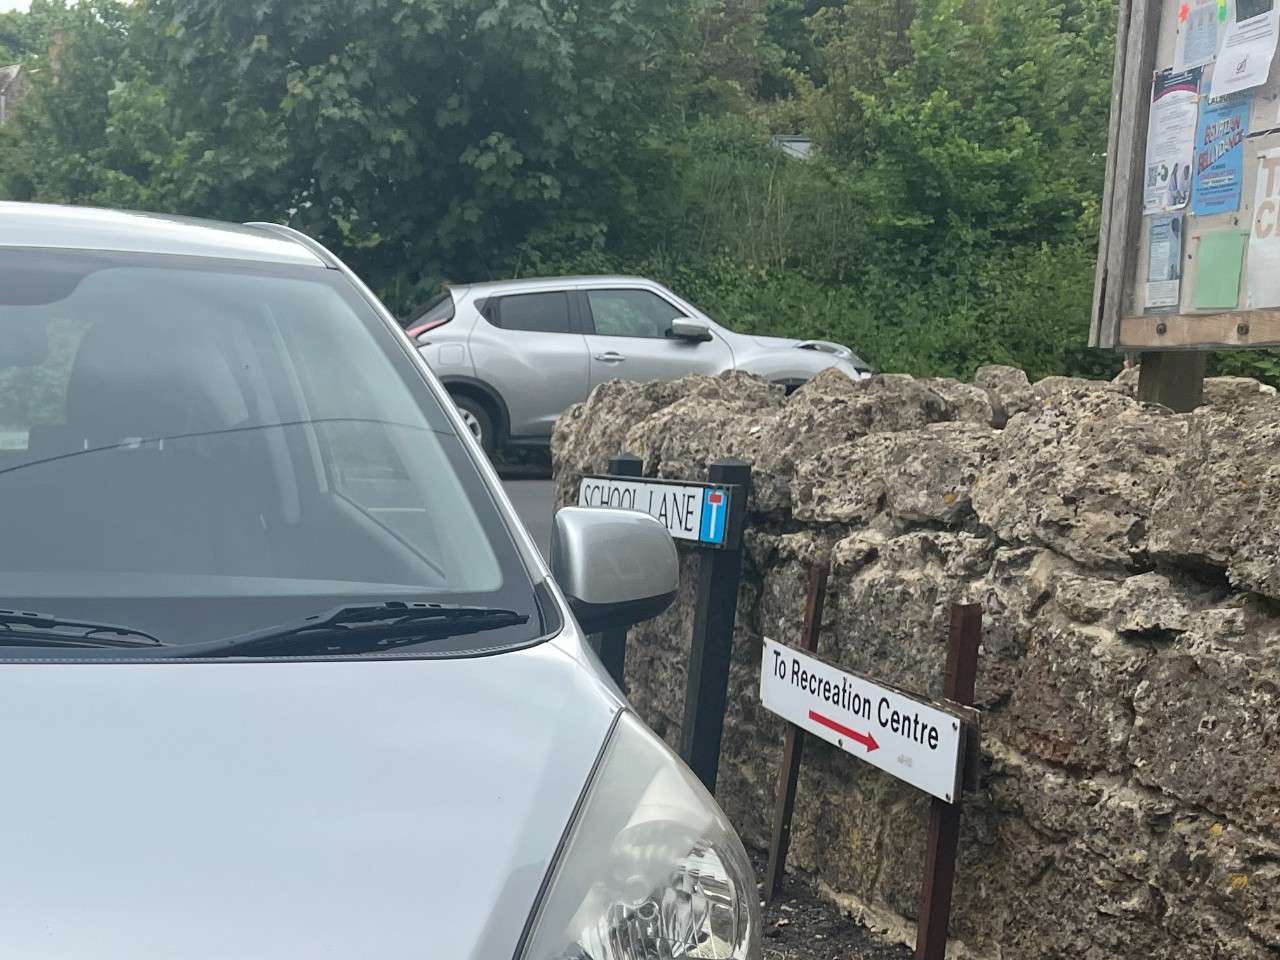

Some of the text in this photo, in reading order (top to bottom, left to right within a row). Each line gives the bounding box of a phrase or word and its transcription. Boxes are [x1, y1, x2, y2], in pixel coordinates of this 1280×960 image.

[584, 484, 695, 532] SCHOOL LANE
[773, 650, 939, 750] To Recreation Centre
